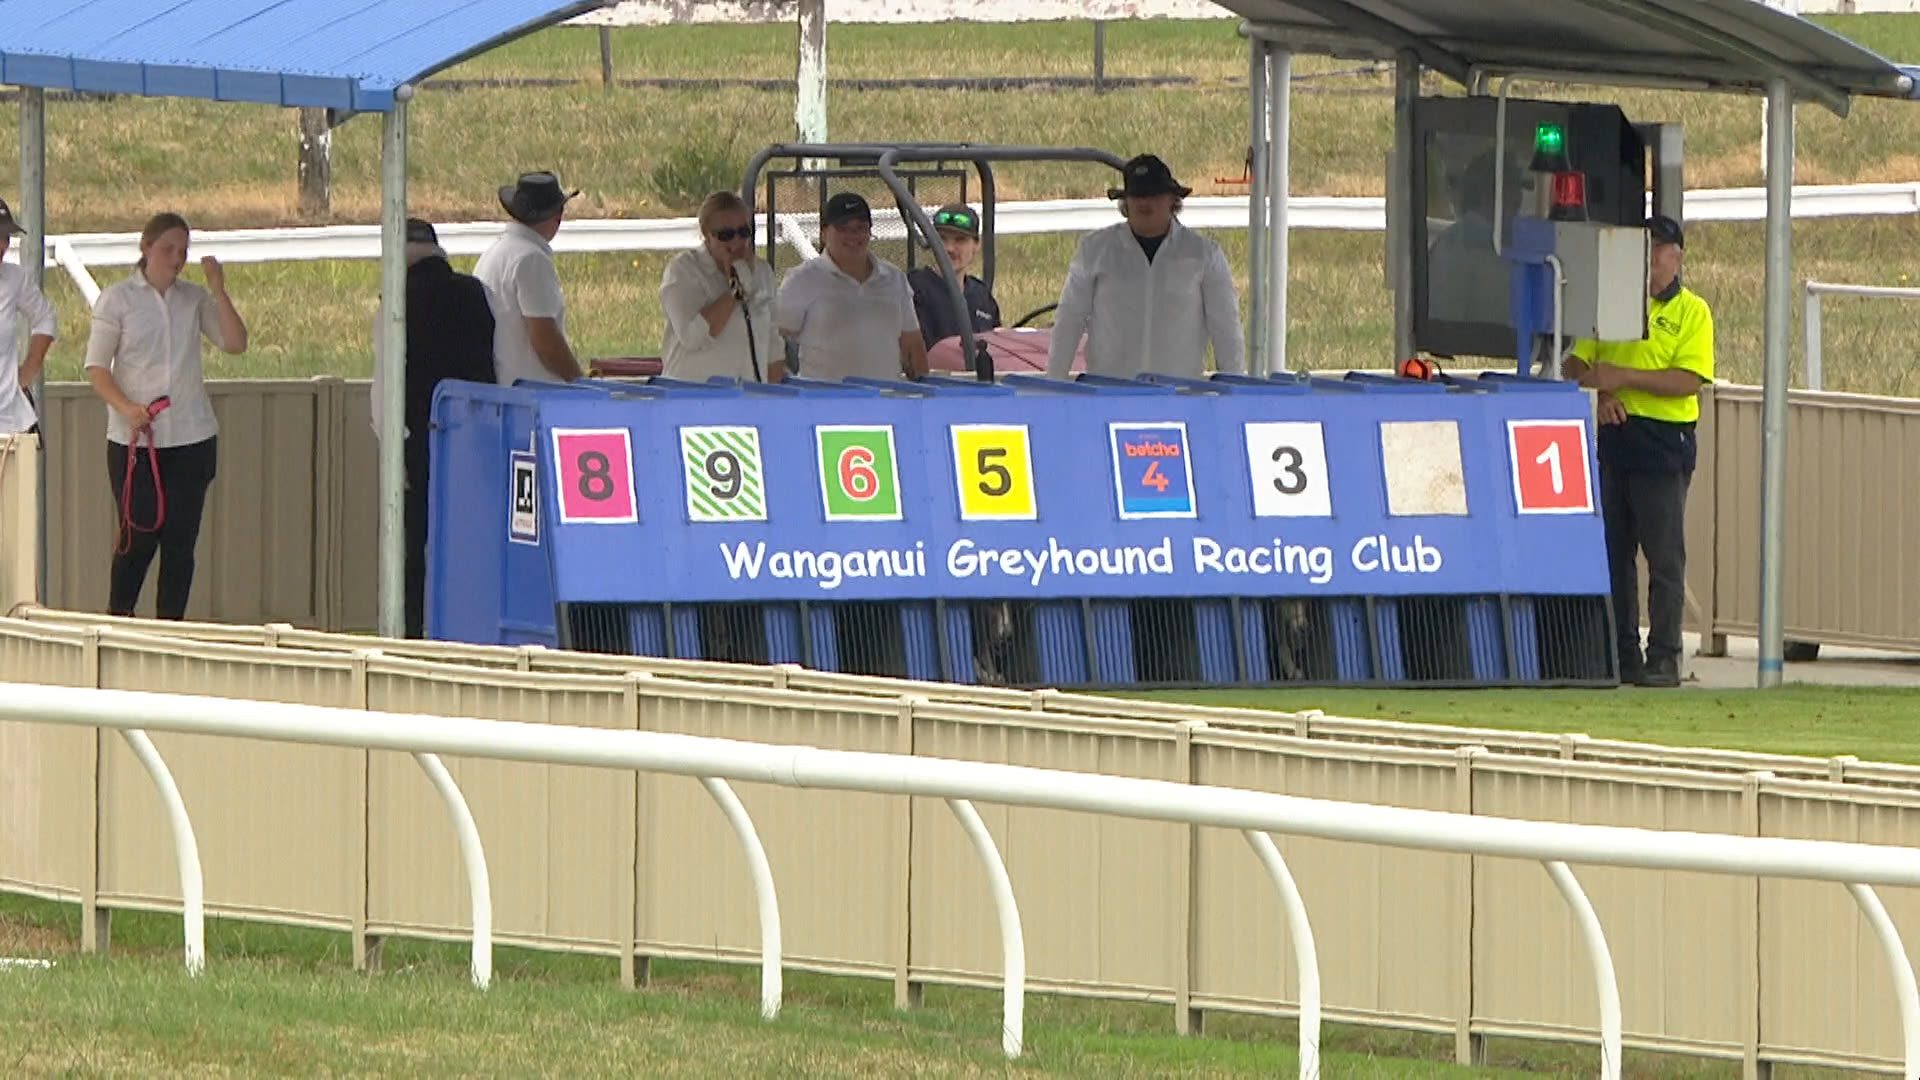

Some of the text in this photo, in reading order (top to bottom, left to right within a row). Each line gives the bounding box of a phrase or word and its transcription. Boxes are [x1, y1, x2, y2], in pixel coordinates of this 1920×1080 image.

[840, 449, 879, 499] 6
[977, 448, 1012, 497] 5
[1124, 442, 1180, 457] betcha
[1271, 446, 1308, 495] 3
[1536, 441, 1564, 494] 1
[578, 451, 614, 500] 8
[706, 451, 742, 499] 9
[1142, 461, 1169, 492] 4
[720, 535, 1442, 589] Wanganui Greyhound Racing Club
